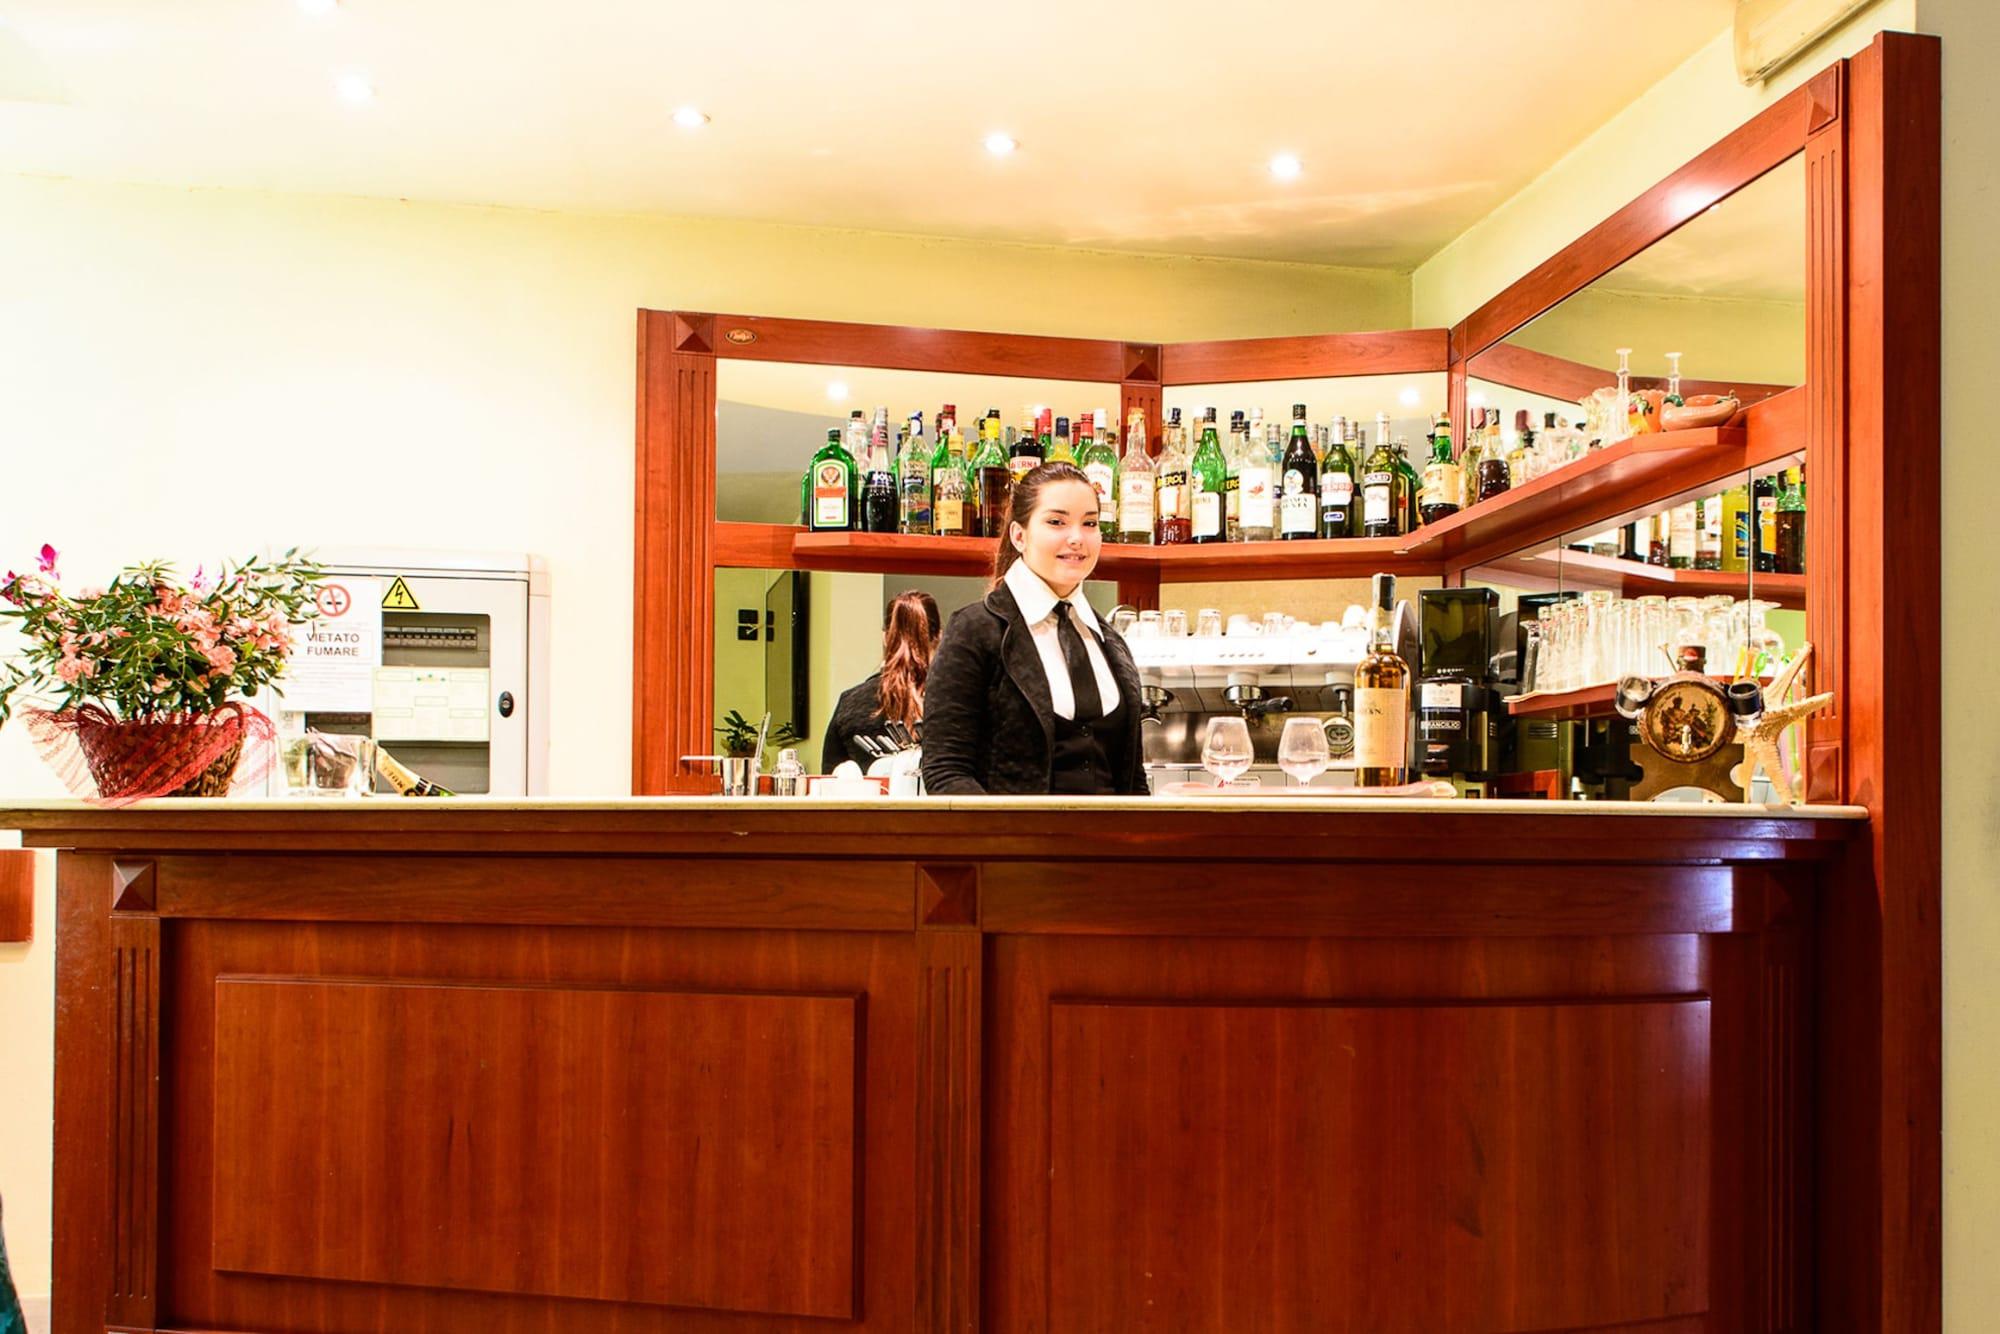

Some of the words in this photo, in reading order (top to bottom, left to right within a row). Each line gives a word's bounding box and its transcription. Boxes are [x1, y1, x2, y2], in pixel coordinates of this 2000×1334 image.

[1156, 474, 1184, 488] AEROL
[306, 632, 360, 643] VIETATO
[307, 646, 360, 657] FUMARE
[1425, 721, 1460, 729] ANCILIO
